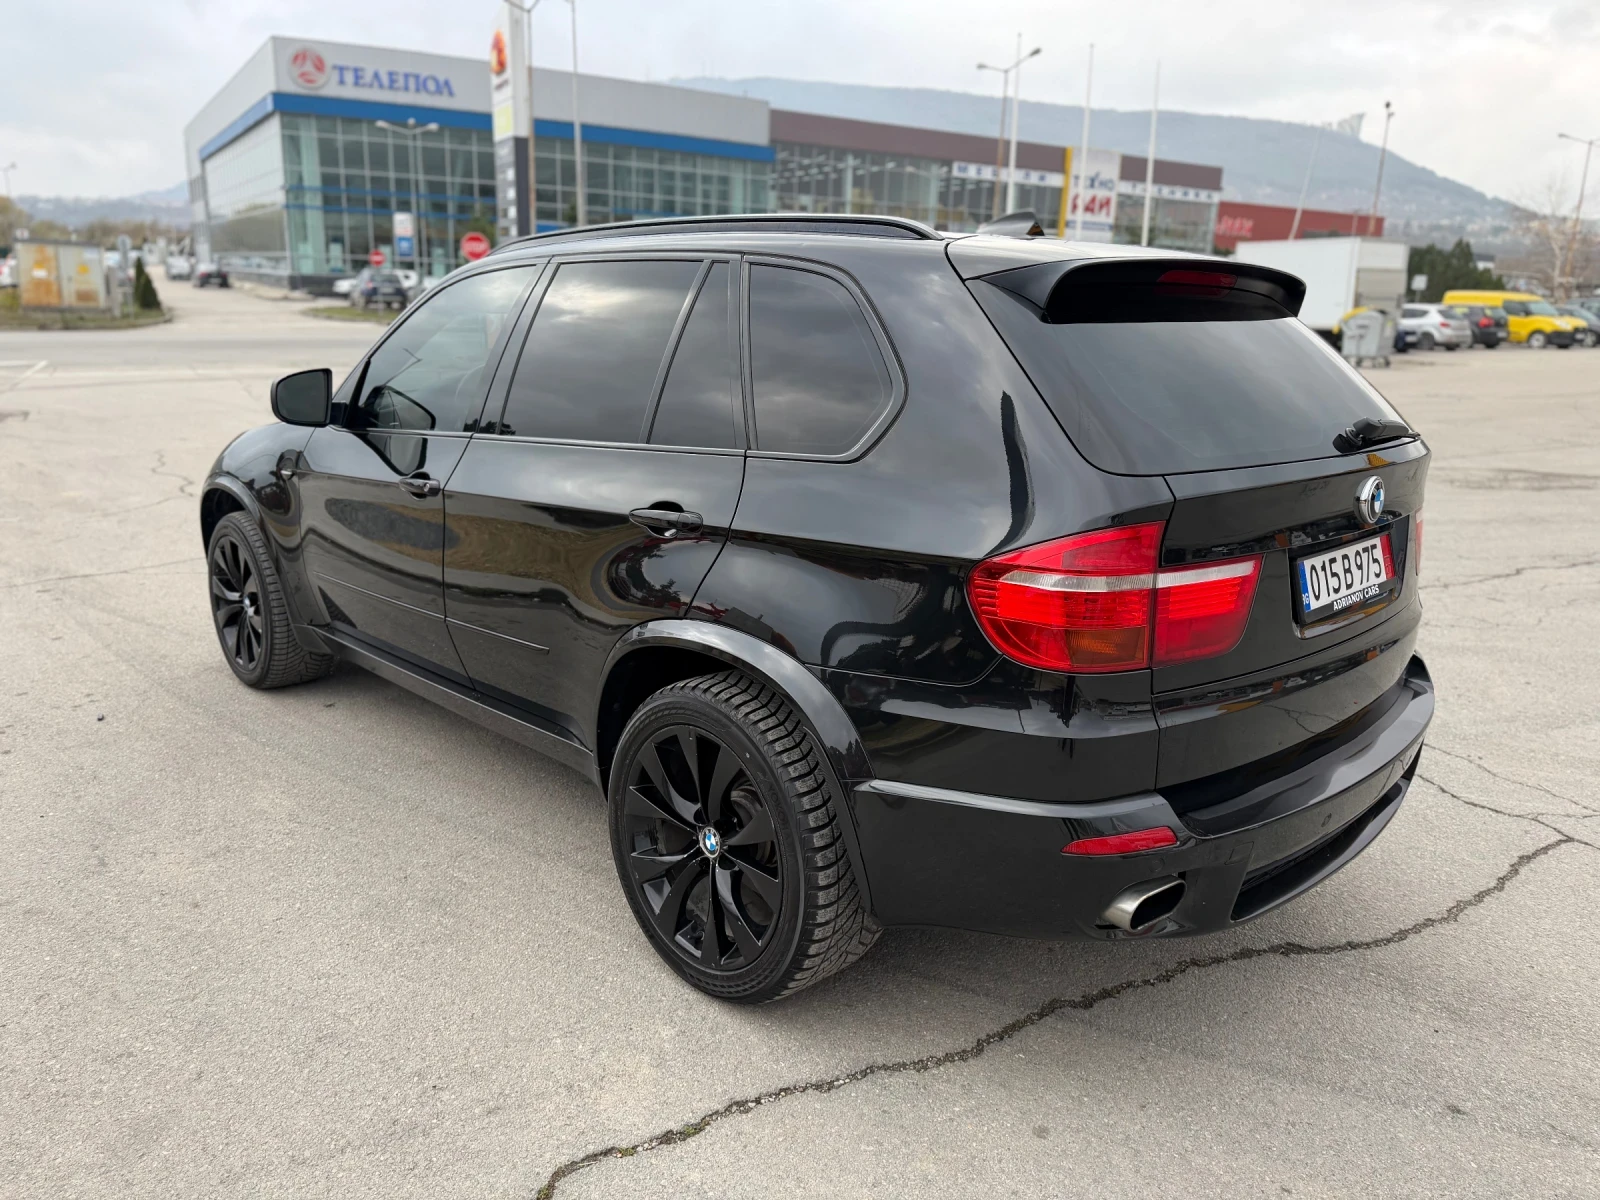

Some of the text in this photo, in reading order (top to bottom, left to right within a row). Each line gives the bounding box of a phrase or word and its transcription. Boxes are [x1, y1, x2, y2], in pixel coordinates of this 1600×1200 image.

[332, 63, 456, 97] ТЕЛЕПОЛ
[1333, 584, 1380, 611] ADRIANOV CARS
